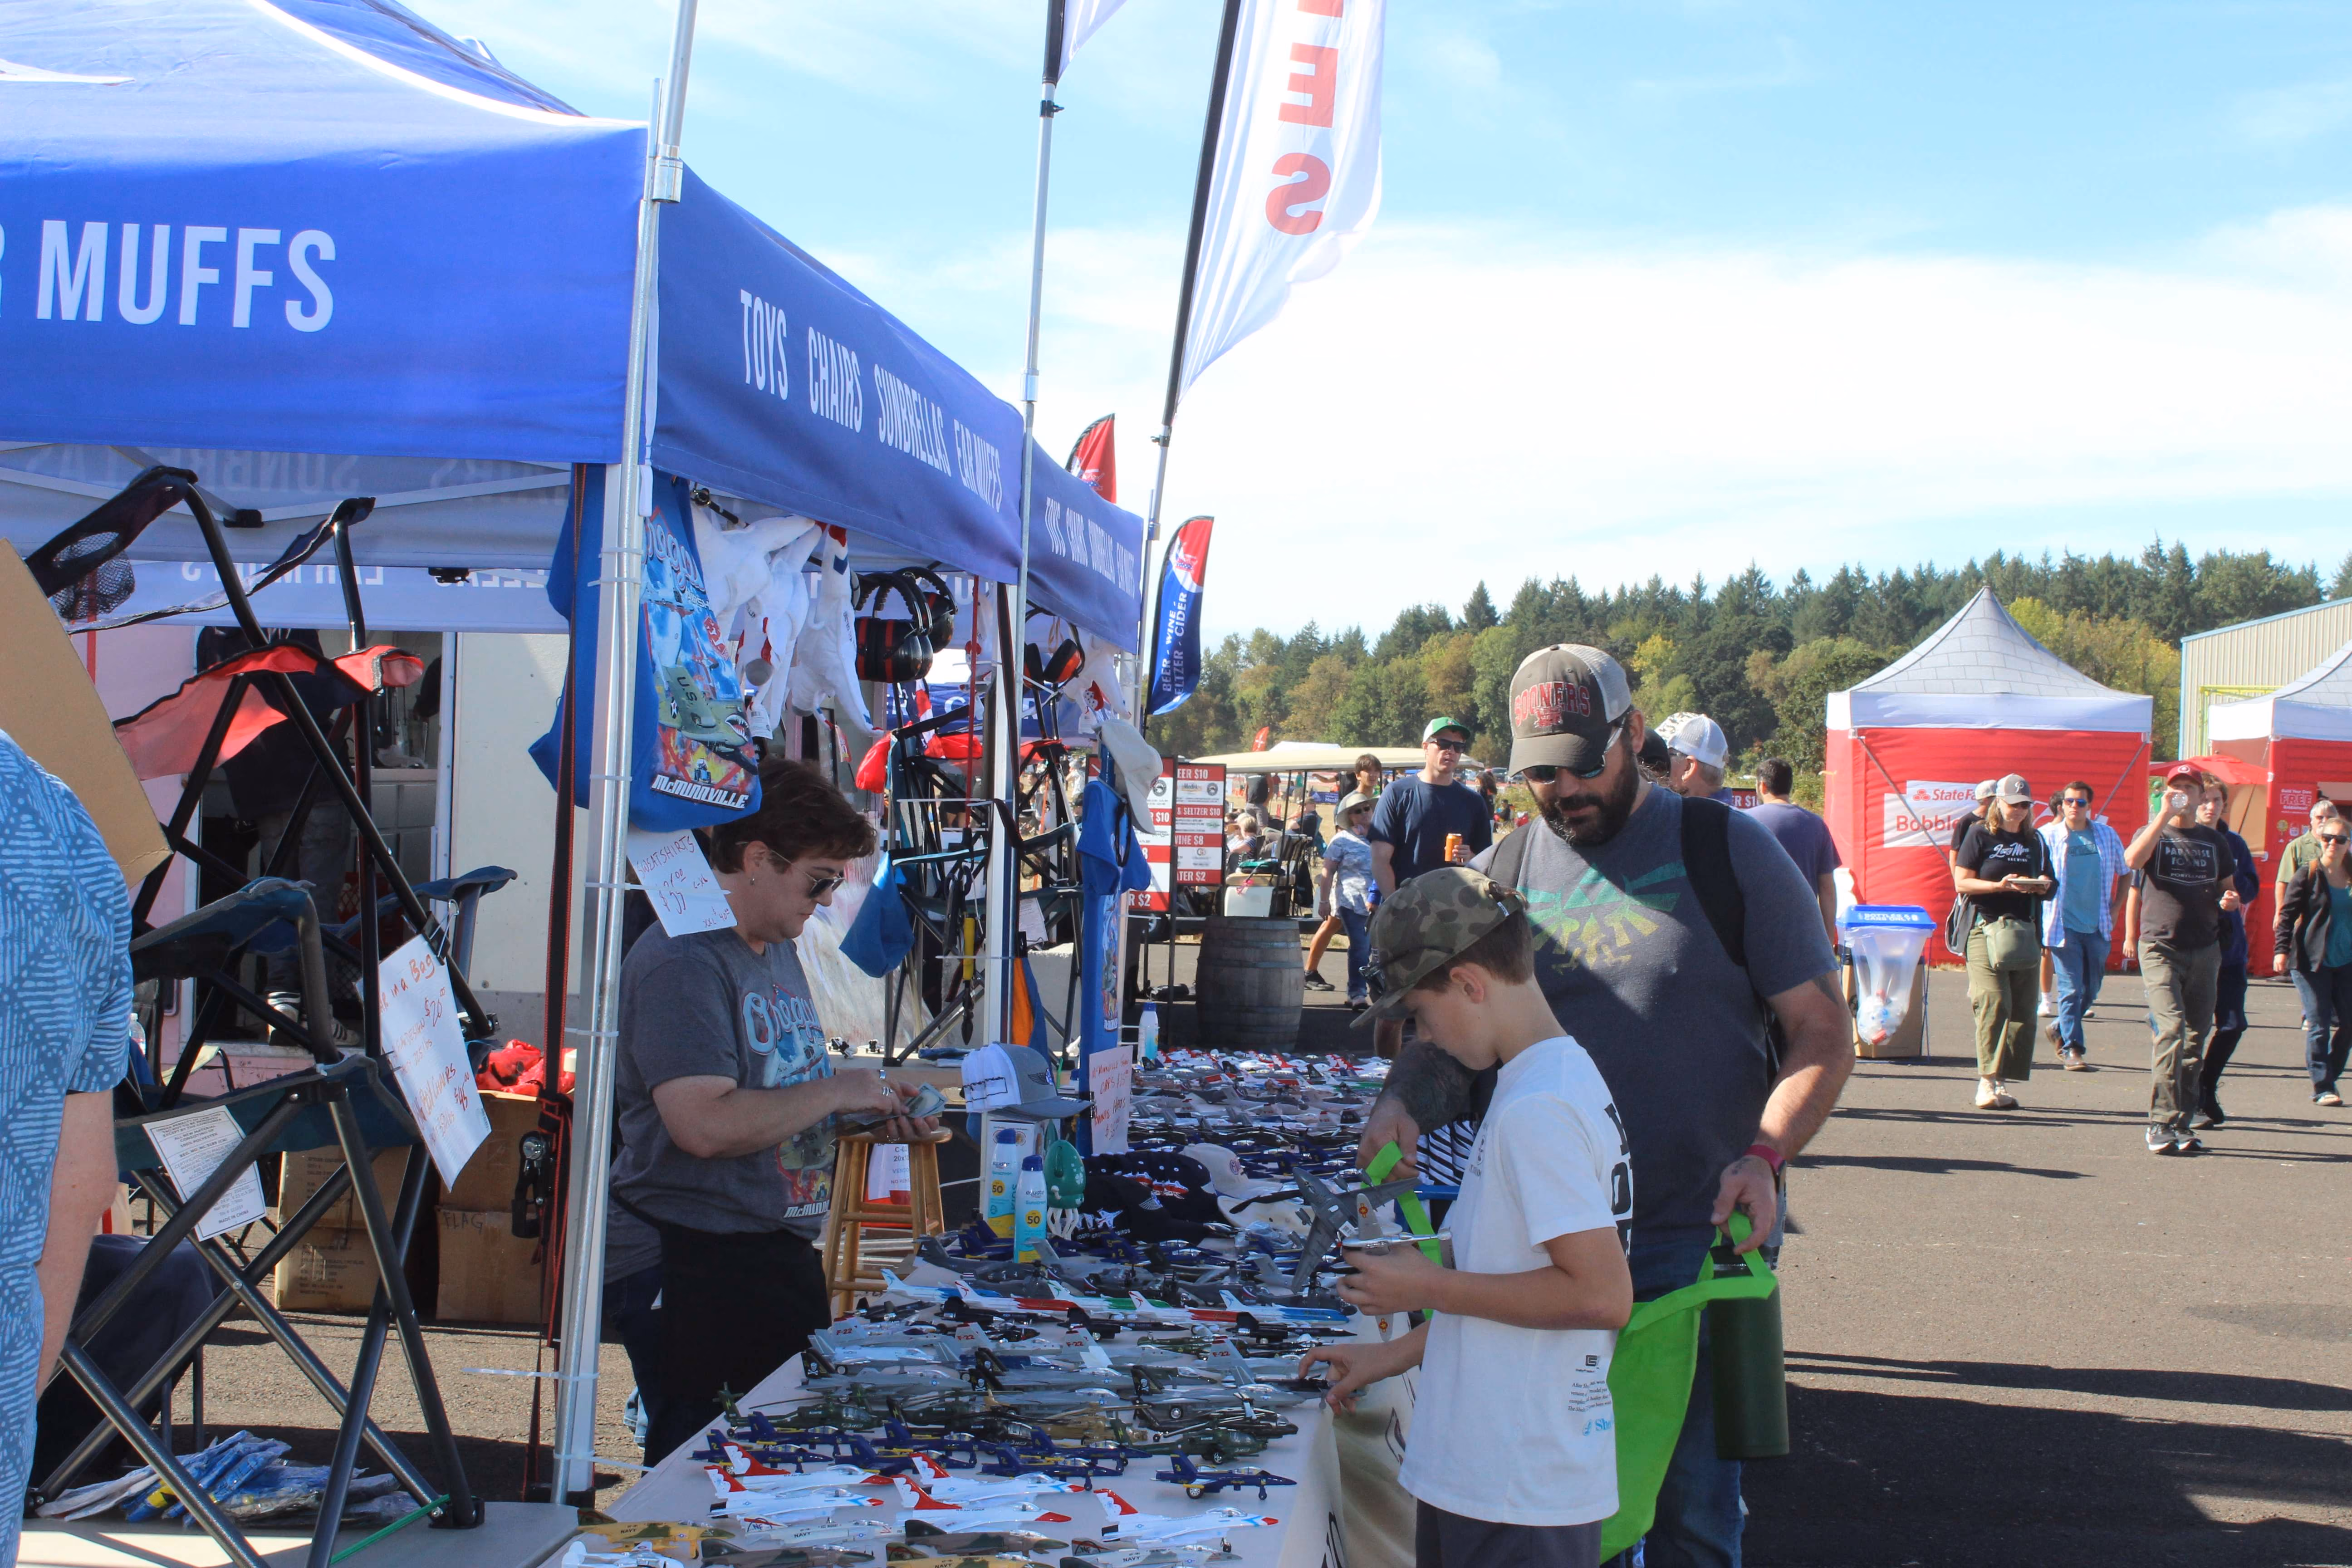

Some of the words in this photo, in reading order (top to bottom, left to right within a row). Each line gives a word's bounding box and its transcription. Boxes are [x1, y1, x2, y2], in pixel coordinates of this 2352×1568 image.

[37, 220, 336, 333] MUFFS
[740, 289, 788, 400] TOYS
[809, 327, 863, 433] CHAIRS
[874, 364, 951, 477] SUNBRELLAS
[1175, 592, 1187, 637] CIDER
[1161, 658, 1171, 692] BEER
[1166, 610, 1176, 645] WINE
[1514, 681, 1591, 727] SOONERS
[1194, 769, 1209, 779] $10
[2280, 793, 2313, 806] FREE
[1183, 807, 1209, 816] SELTZER
[1210, 807, 1221, 816] $10
[1156, 812, 1170, 823] $10
[1194, 835, 1204, 846] $8
[636, 835, 695, 879] SWEATSHIRTS
[2171, 857, 2207, 867] FOND
[1196, 871, 1206, 882] $2
[1138, 894, 1151, 906] $2
[408, 953, 436, 983] Bag
[991, 1184, 1003, 1194] 50
[236, 1209, 249, 1217] CHINA
[442, 1212, 484, 1235] FLAG
[1026, 1215, 1040, 1225] 50
[1118, 1249, 1124, 1257] 2
